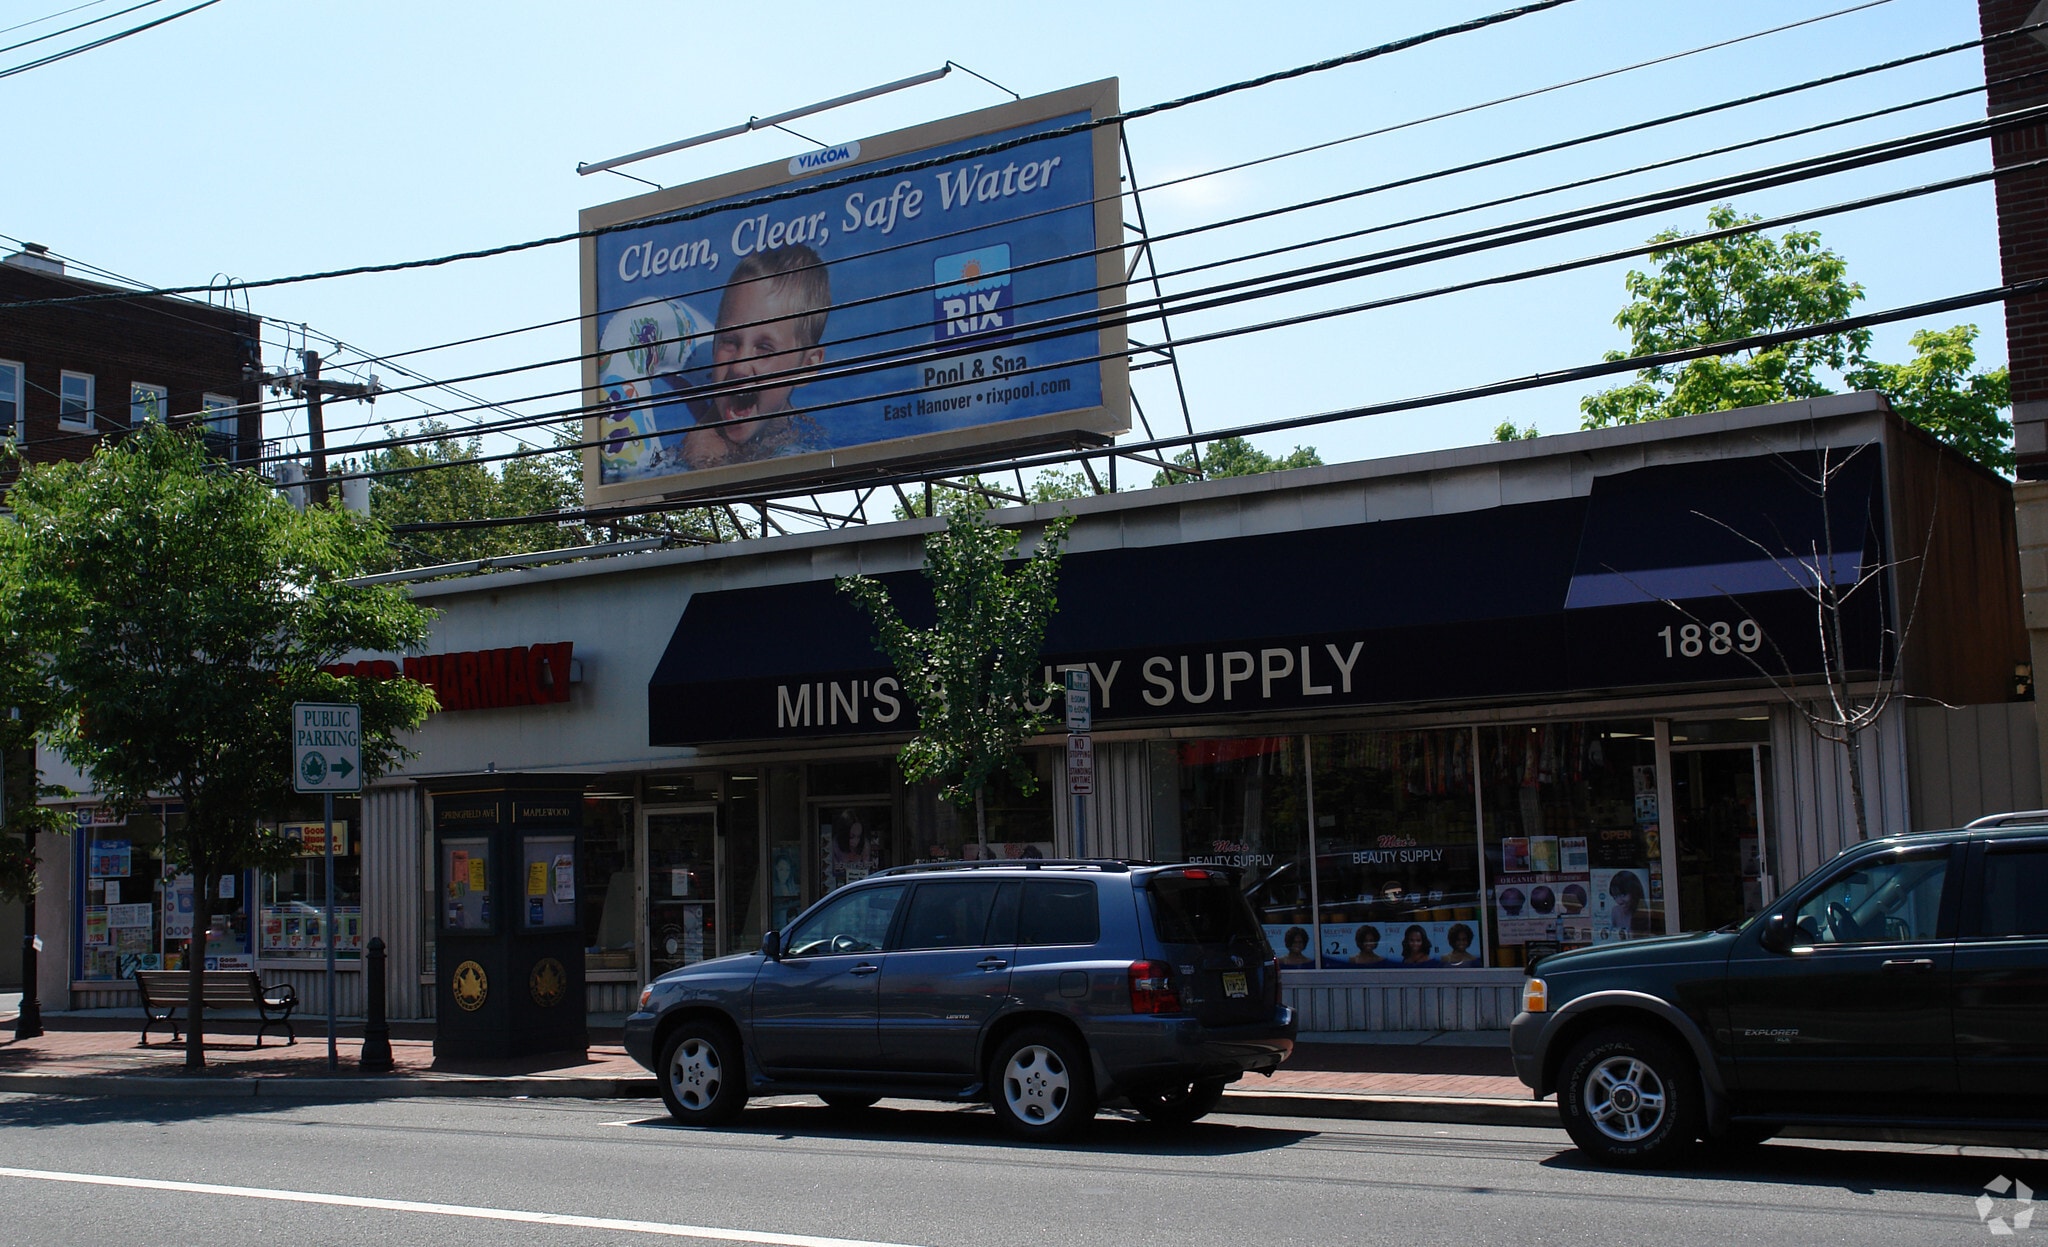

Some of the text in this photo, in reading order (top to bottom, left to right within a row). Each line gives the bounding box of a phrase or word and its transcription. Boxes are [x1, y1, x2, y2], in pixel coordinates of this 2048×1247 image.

[798, 146, 850, 169] VIACOM
[619, 156, 1061, 281] Clean, Clear, Safe Water
[943, 291, 1003, 336] RIX
[924, 355, 1027, 387] Pool & Spa
[884, 378, 1071, 421] East Hanover rixpool.com
[1657, 618, 1763, 659] 1889
[777, 676, 901, 728] MIN'S
[1142, 642, 1364, 707] SUPPLY
[304, 710, 351, 727] PUBLIC
[297, 730, 357, 747] PARKING
[1074, 738, 1085, 750] NO
[481, 808, 496, 818] AVE
[522, 808, 570, 817] MAPLEWOOD
[1600, 829, 1632, 840] OPEN
[1233, 854, 1274, 867] SUPPLY
[1352, 849, 1443, 865] BEAUTY SUPPLY
[1330, 941, 1341, 955] 2
[1744, 1028, 1800, 1036] EXPLORER
